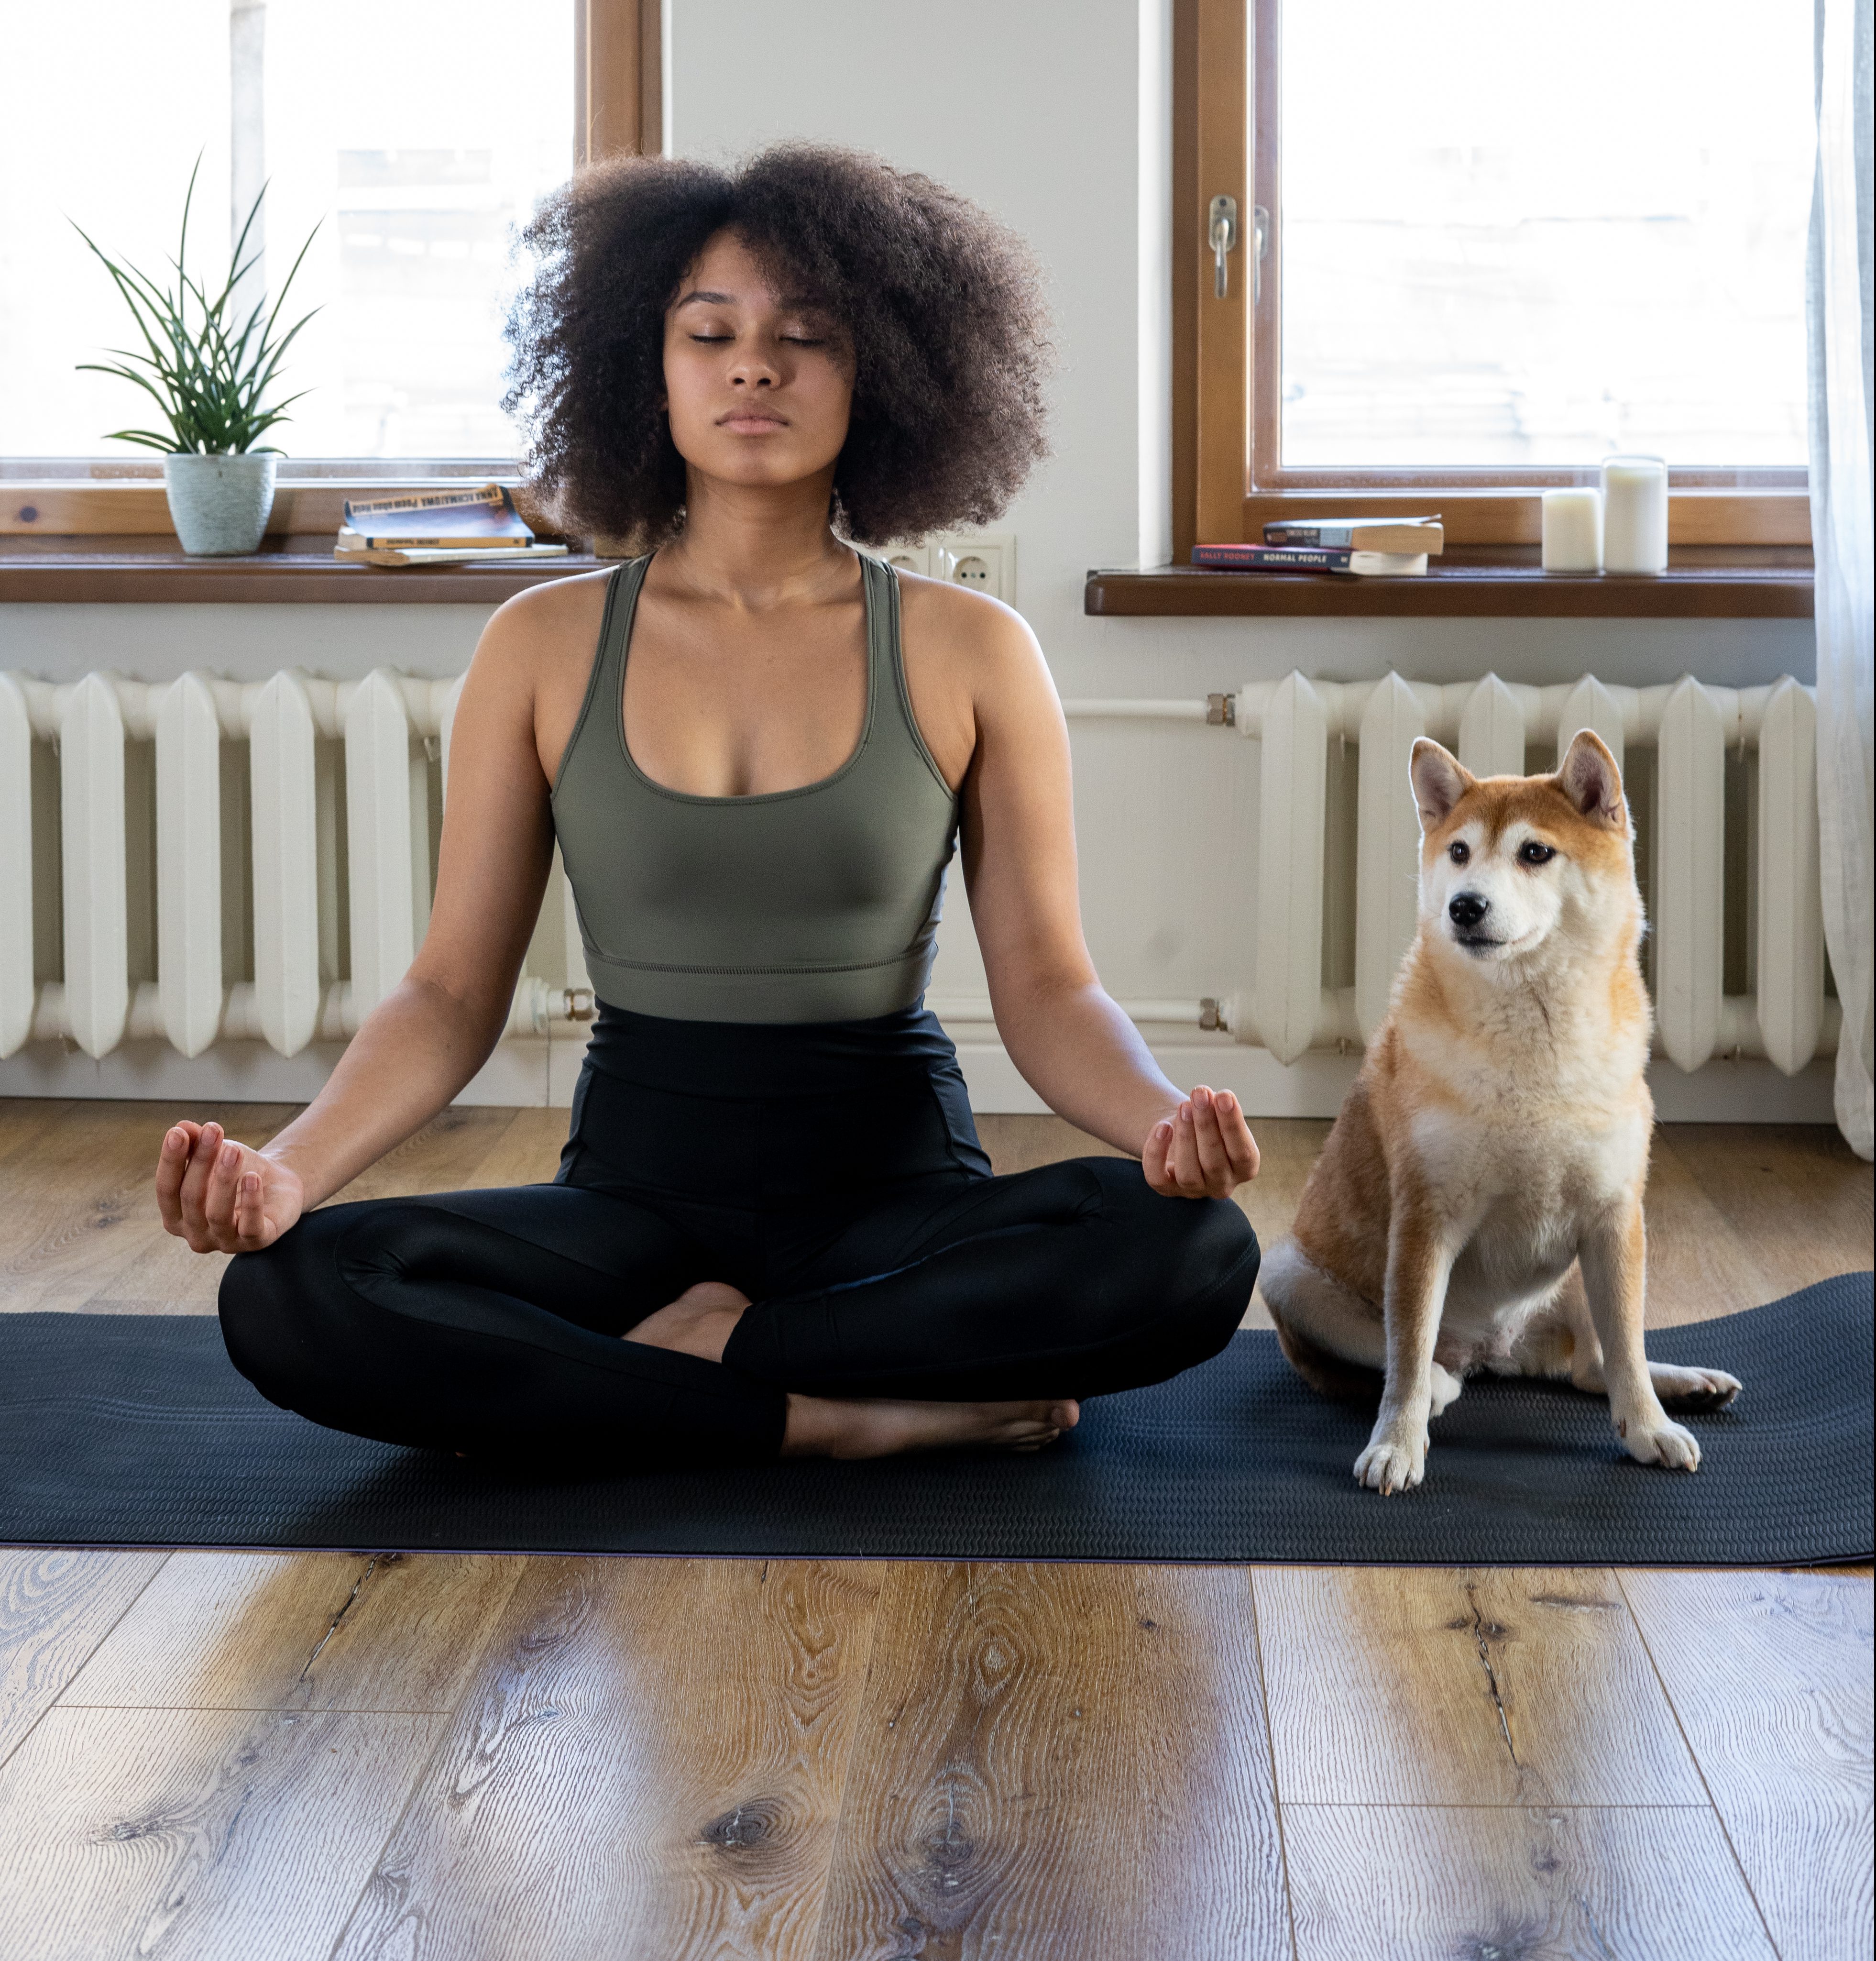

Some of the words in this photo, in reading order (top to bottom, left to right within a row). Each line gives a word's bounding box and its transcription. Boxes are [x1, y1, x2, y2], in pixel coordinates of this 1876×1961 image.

[1200, 551, 1221, 560] SALLY
[1224, 553, 1255, 561] ROONEY
[1263, 553, 1295, 562] NORMAL
[1298, 554, 1327, 563] PEOPLE
